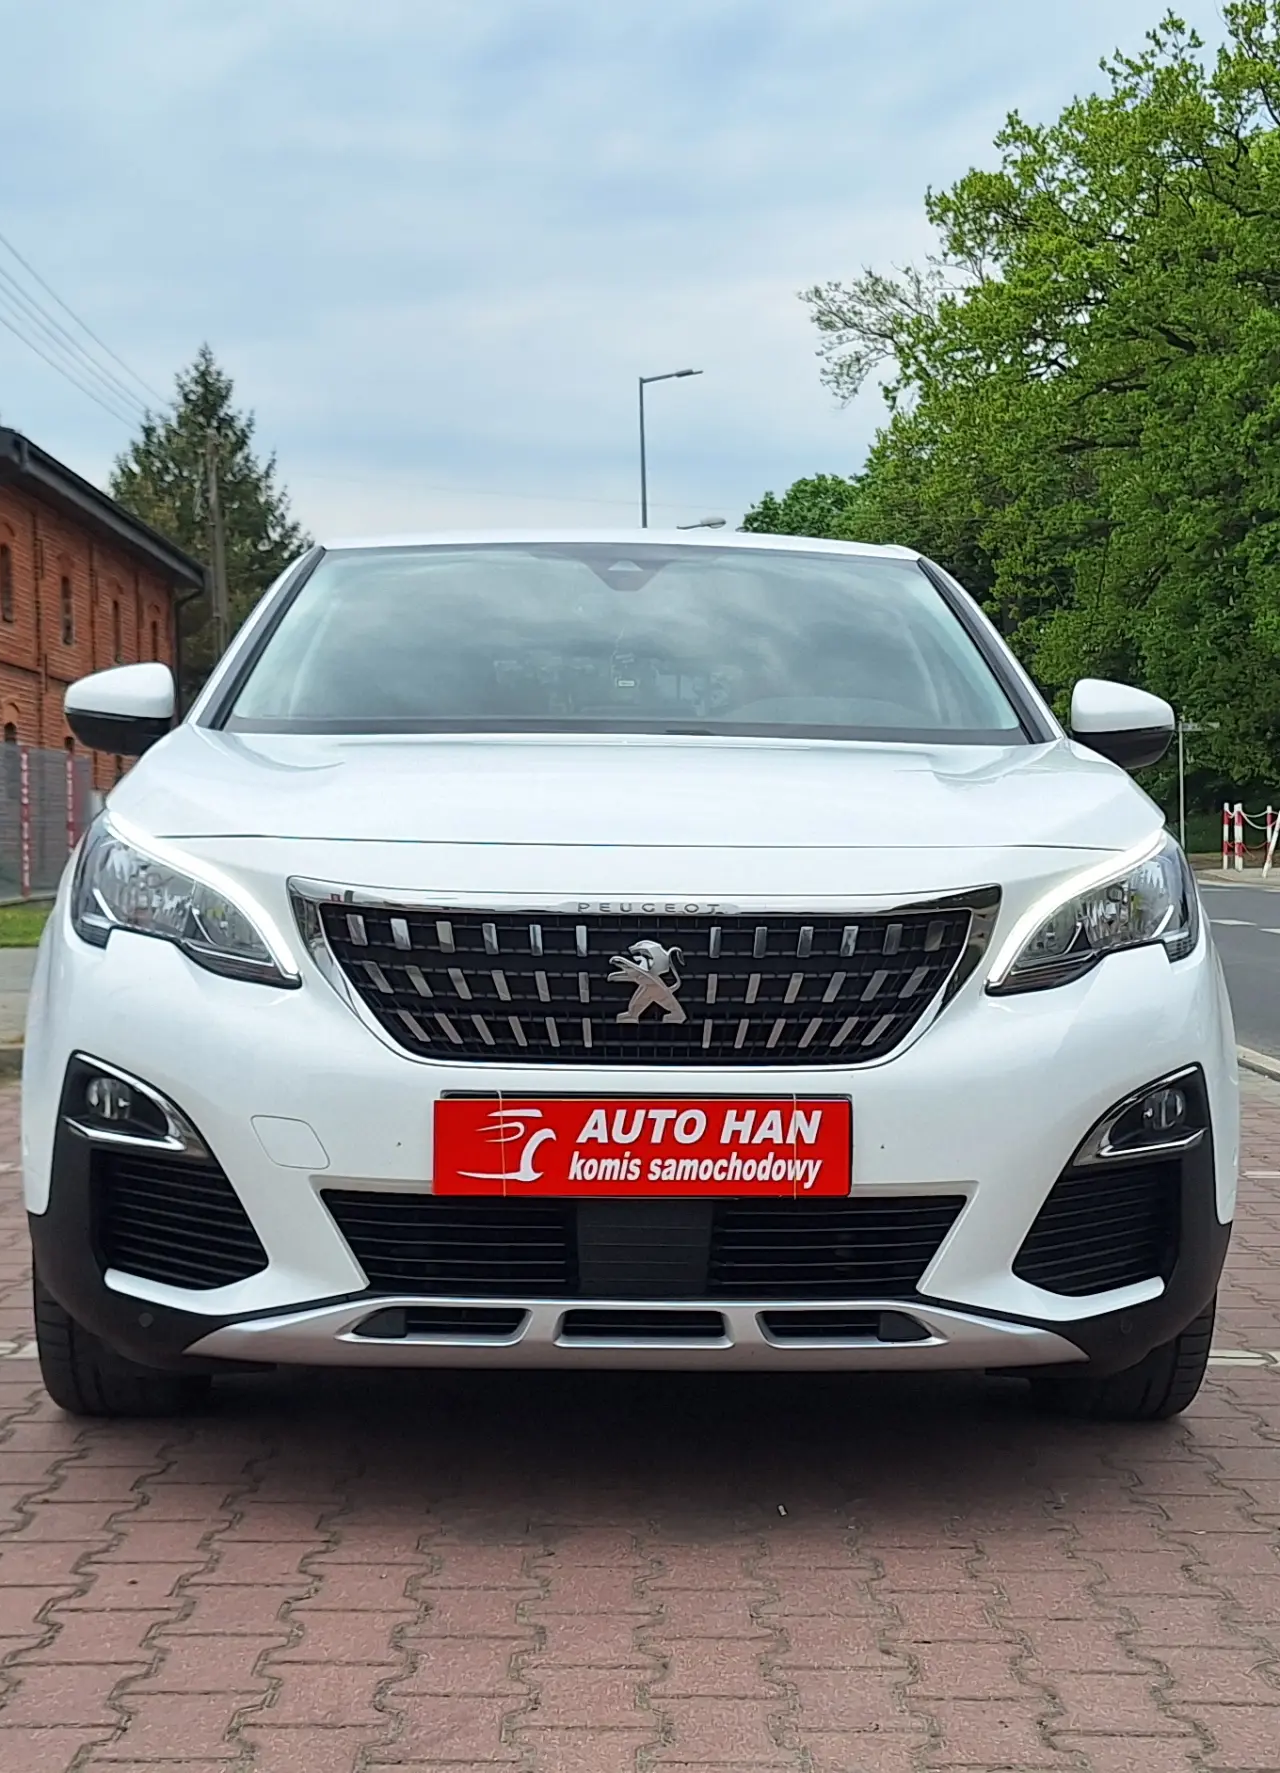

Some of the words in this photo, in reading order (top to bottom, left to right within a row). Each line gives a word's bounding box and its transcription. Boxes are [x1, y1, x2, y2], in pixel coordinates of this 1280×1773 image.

[577, 903, 720, 913] PEUGEOT
[576, 1109, 707, 1144] AUTO
[719, 1110, 822, 1144] HAN
[568, 1151, 641, 1181] komis
[647, 1152, 822, 1189] samochodowy
